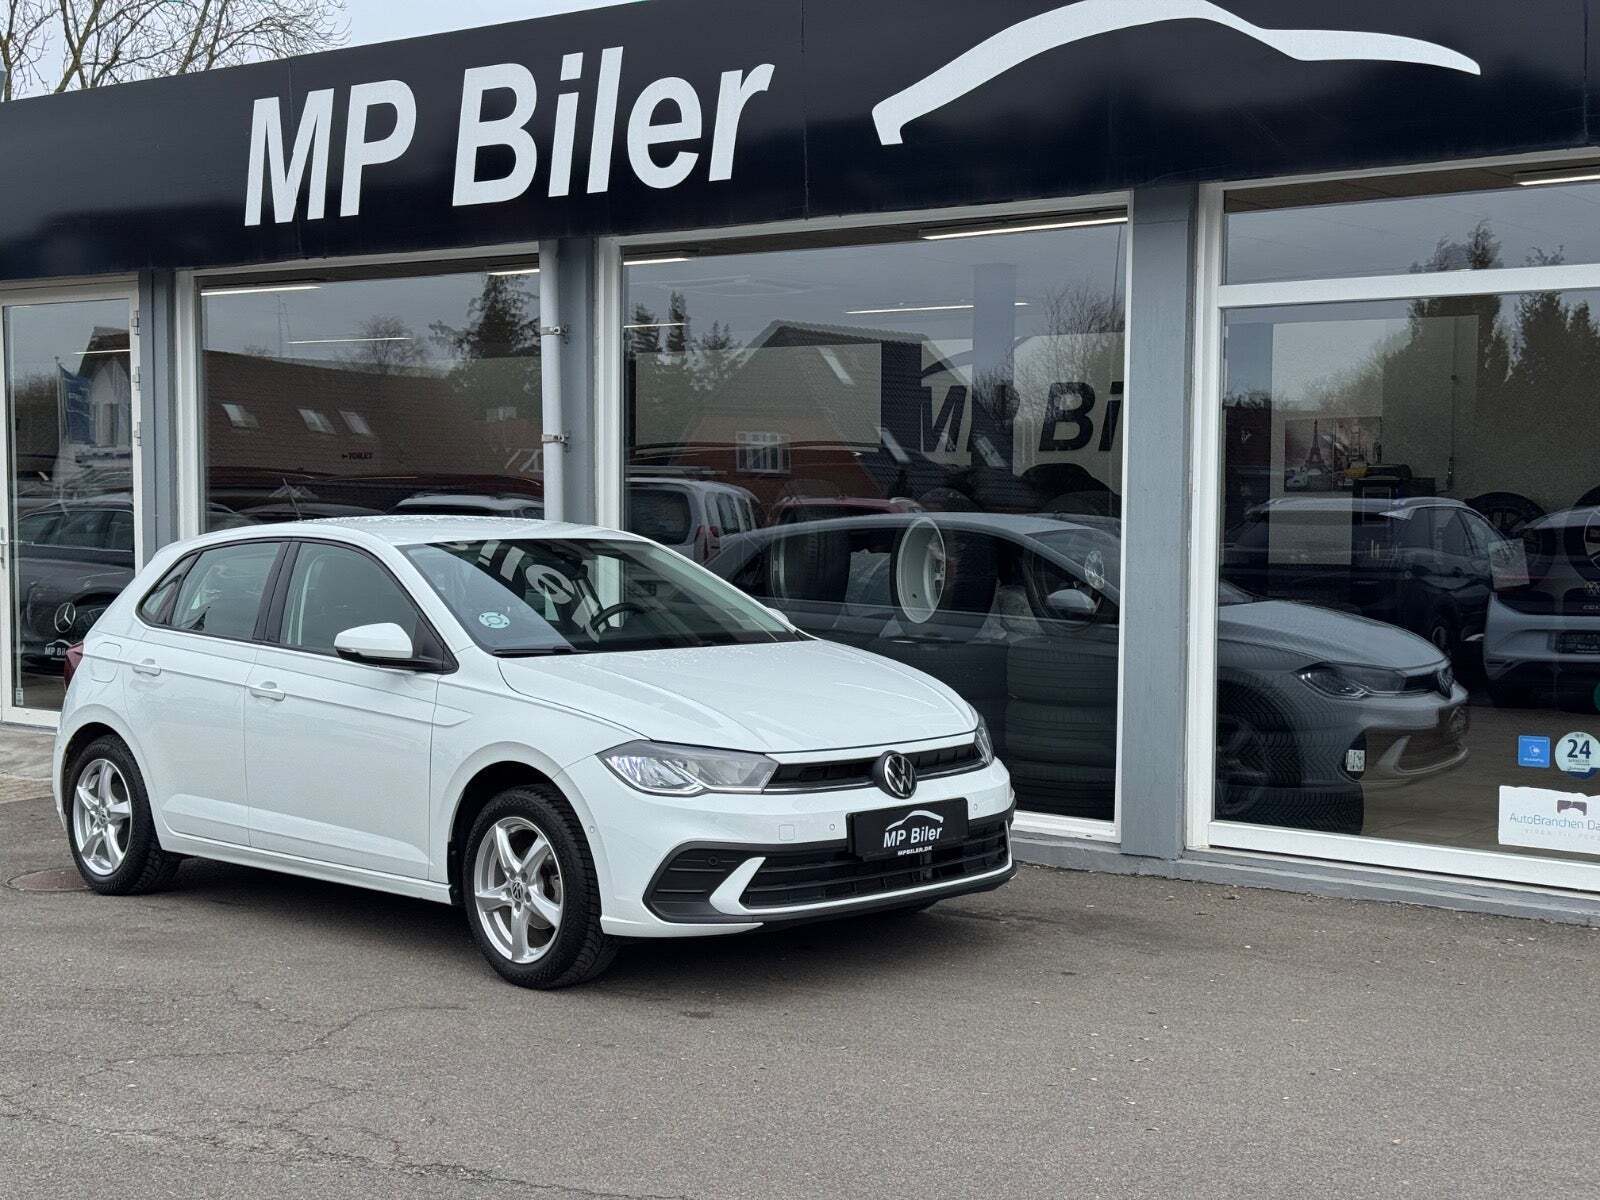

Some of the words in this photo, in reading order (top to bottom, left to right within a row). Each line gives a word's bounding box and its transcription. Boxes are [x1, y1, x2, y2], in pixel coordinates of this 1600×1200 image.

[244, 79, 417, 227] MP
[452, 46, 775, 207] Biler
[1567, 738, 1592, 760] 24
[1509, 812, 1584, 830] AutoBranchen
[883, 829, 906, 848] MP
[910, 825, 943, 844] Biler
